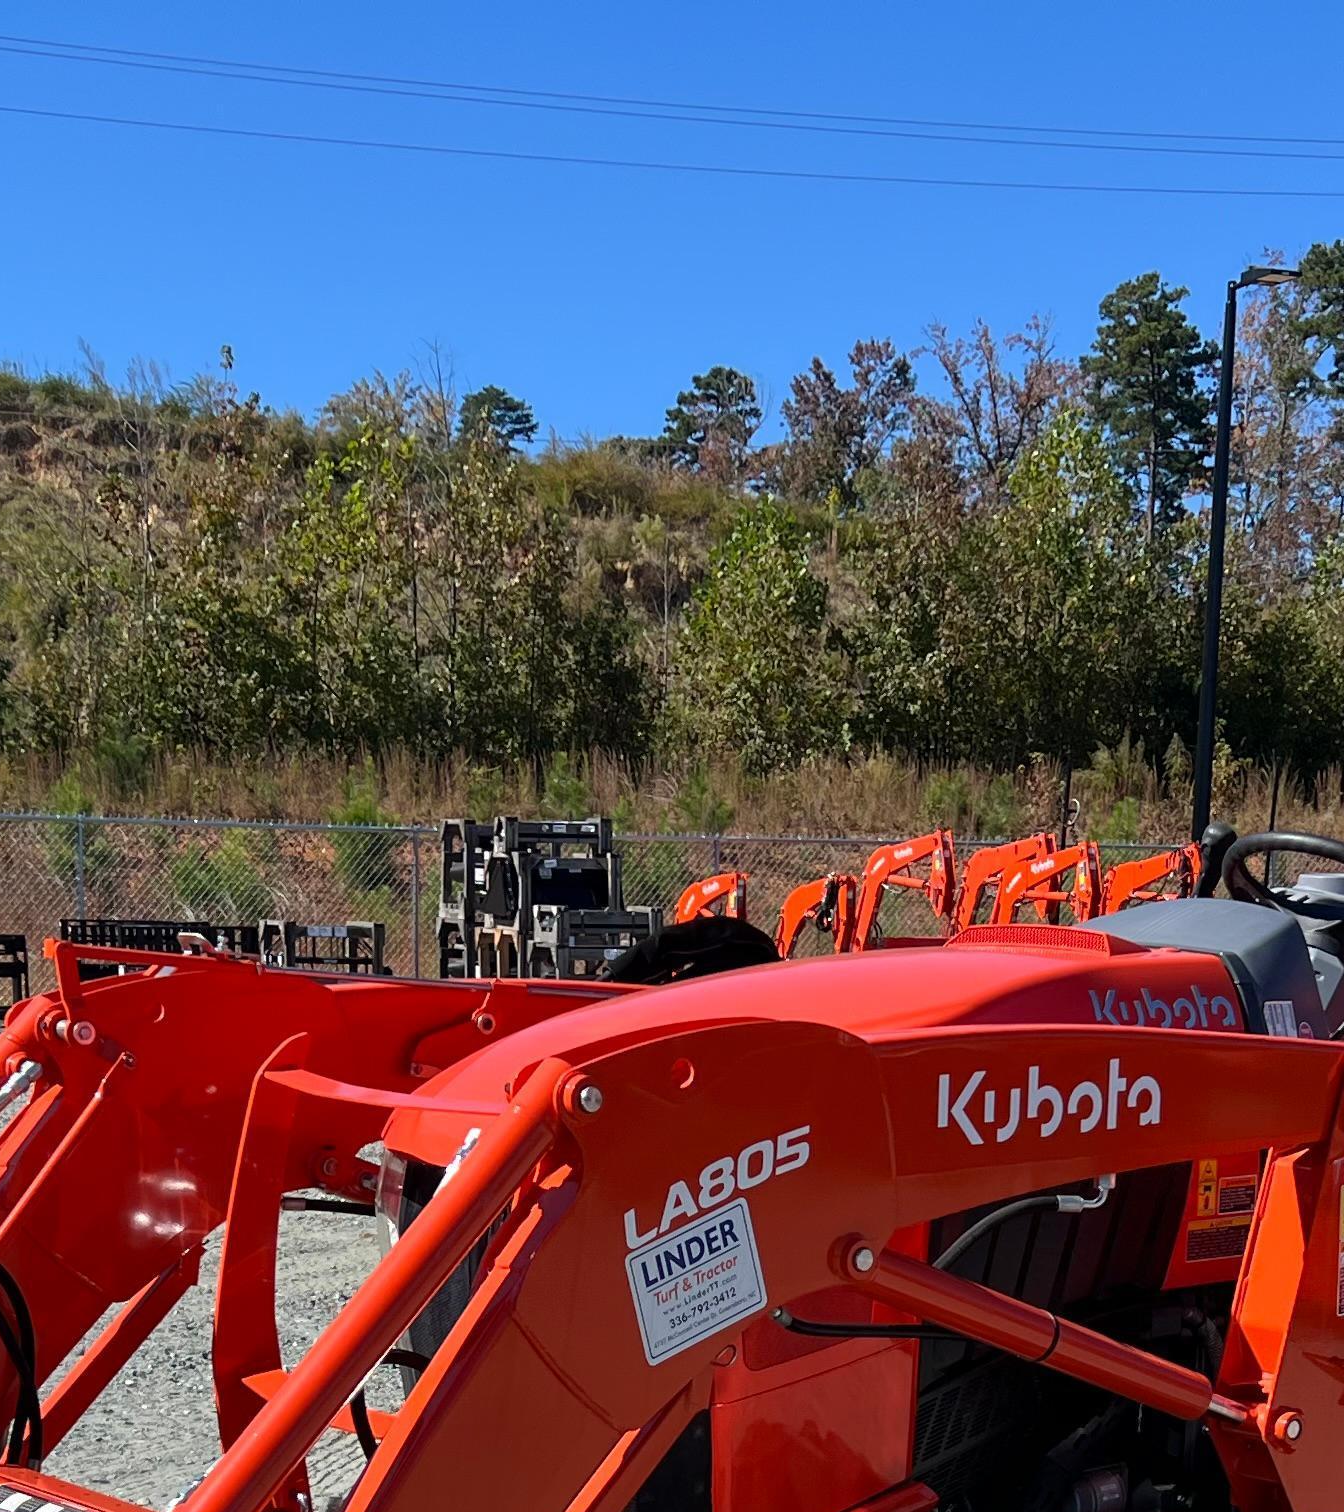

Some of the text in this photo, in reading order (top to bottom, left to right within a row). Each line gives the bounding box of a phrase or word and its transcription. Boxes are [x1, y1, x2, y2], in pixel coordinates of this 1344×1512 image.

[1088, 985, 1237, 1029] Kubota
[937, 1058, 1162, 1146] Kubota
[623, 1125, 811, 1250] LA805
[641, 1219, 740, 1288] LINDER
[654, 1256, 738, 1306] Turf & Tractor
[669, 1287, 737, 1329] 336-792-3412
